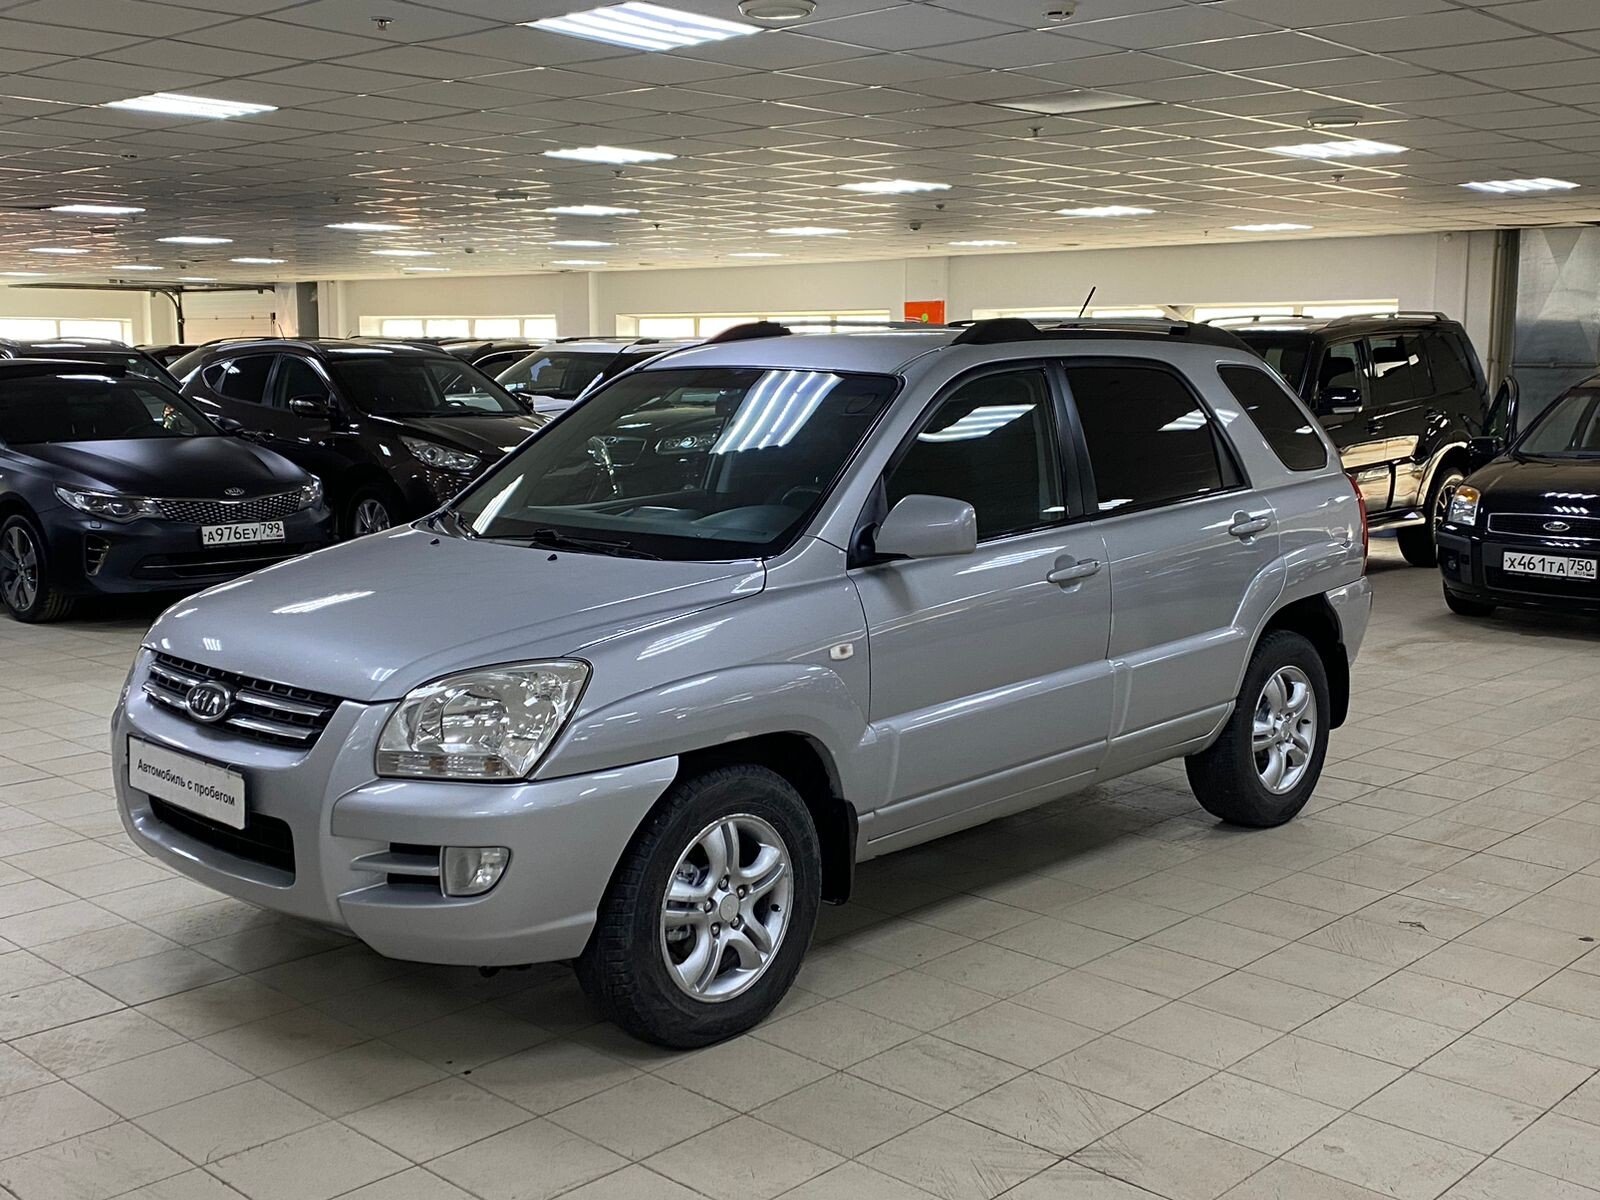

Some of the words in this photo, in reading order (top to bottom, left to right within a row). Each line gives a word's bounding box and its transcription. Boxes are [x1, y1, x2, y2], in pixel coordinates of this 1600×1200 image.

[260, 523, 280, 535] 799
[1569, 559, 1592, 571] 750
[189, 688, 222, 715] KIA
[137, 758, 186, 787] Автомобиль
[187, 779, 193, 790] с
[194, 783, 235, 806] пробегом
